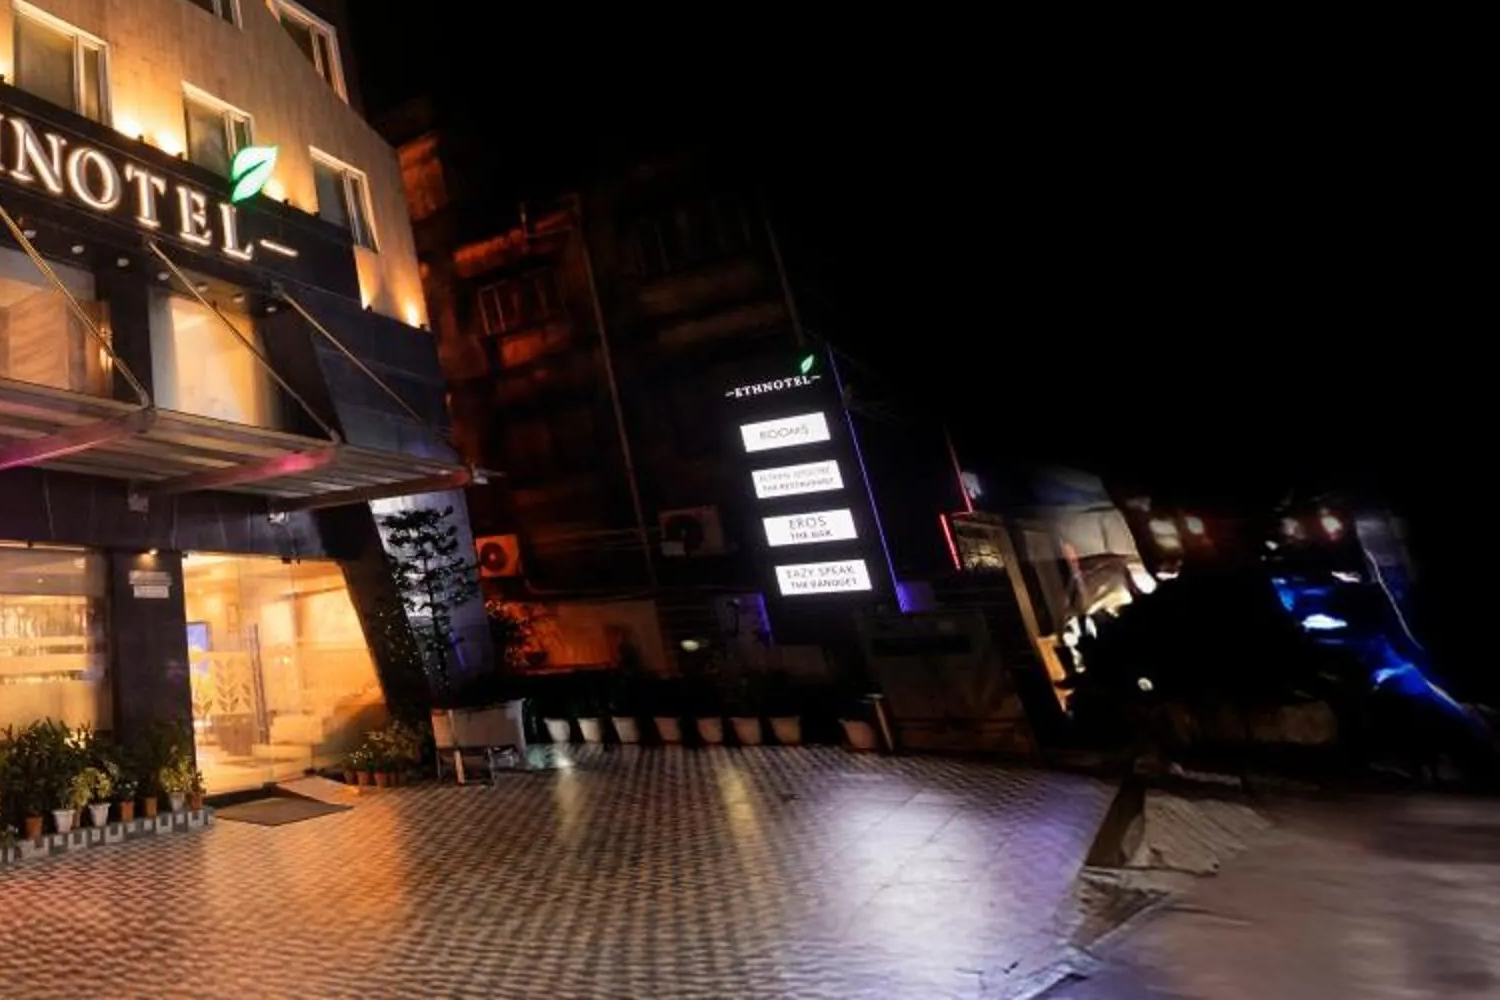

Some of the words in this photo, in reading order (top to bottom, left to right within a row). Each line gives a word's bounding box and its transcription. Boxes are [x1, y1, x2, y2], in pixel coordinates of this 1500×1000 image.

[735, 375, 811, 398] ETHNOTEL
[760, 425, 809, 439] ROOMS
[789, 516, 827, 530] EROS
[818, 564, 853, 577] SPEAK
